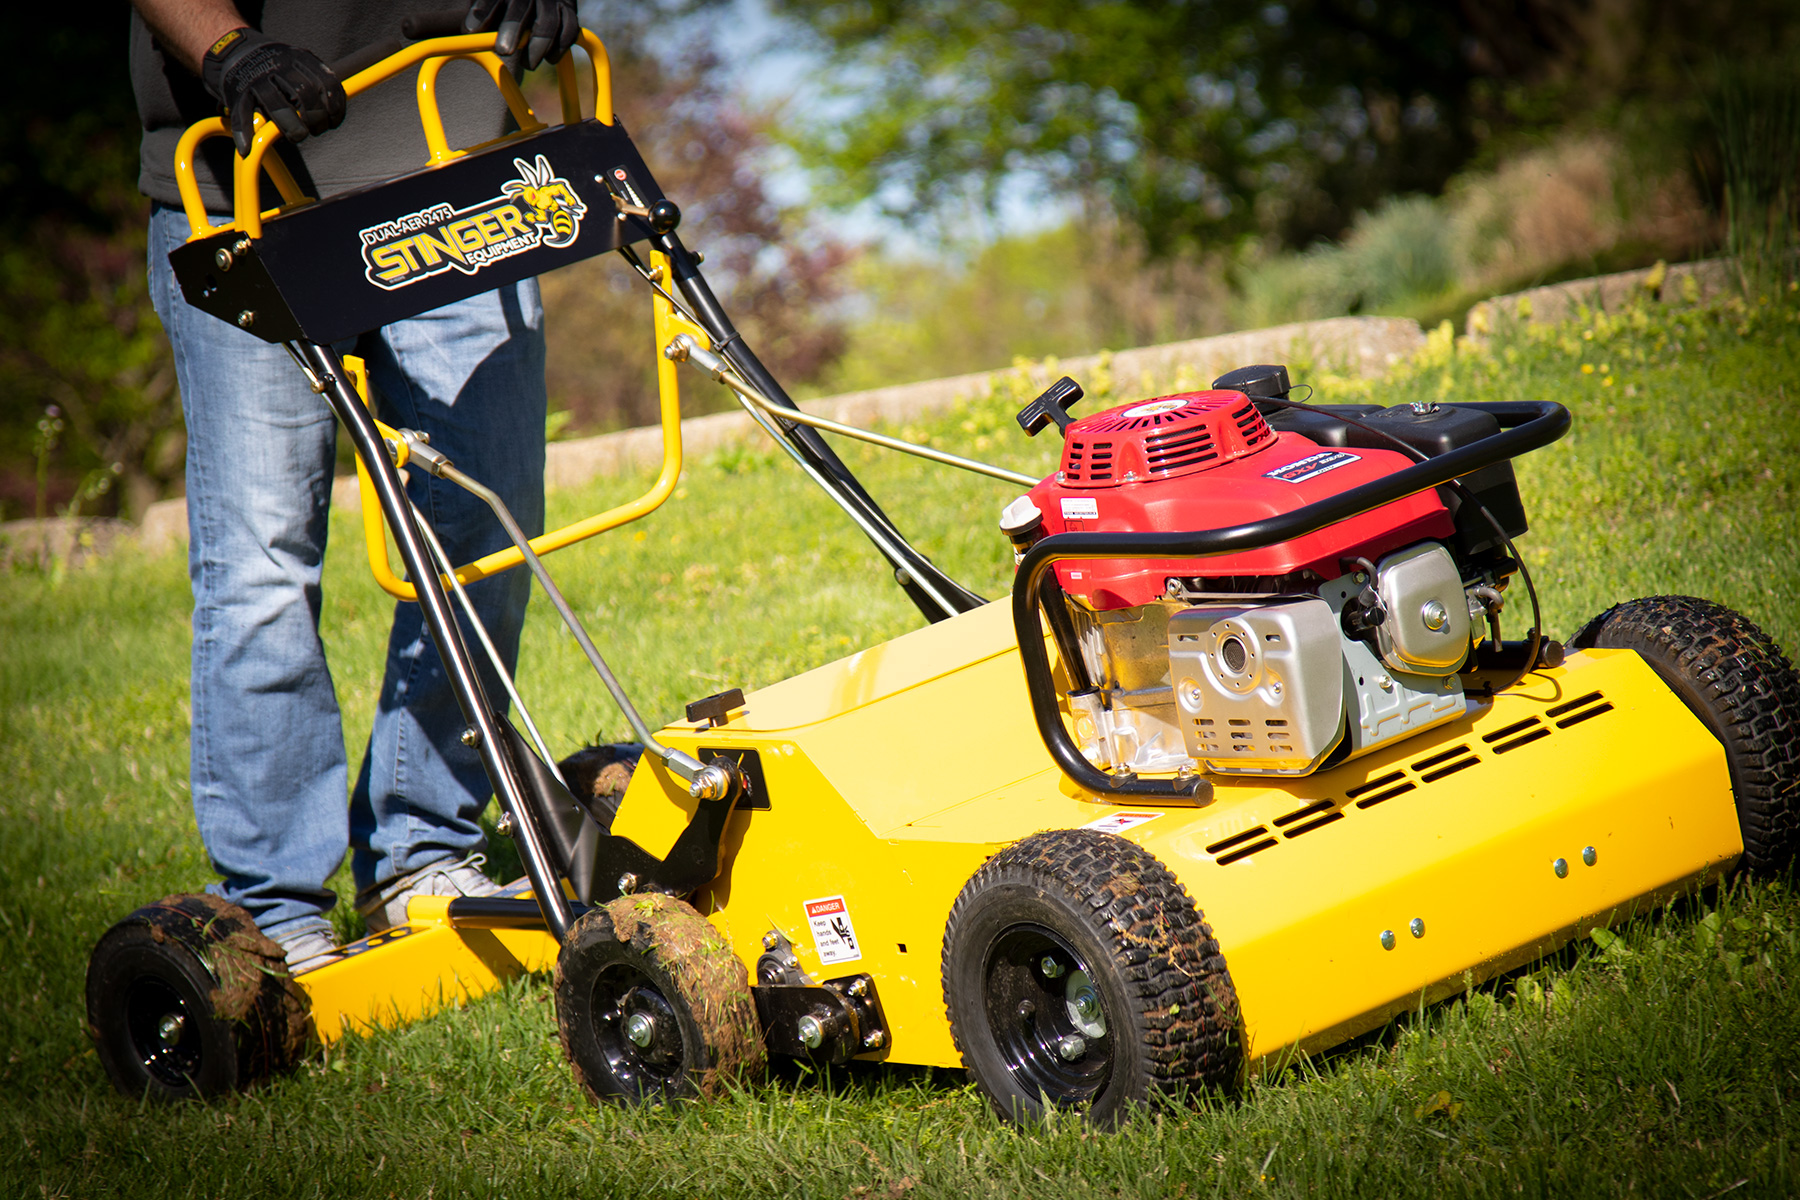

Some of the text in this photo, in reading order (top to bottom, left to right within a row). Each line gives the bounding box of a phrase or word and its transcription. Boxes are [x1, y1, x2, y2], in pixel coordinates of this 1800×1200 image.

[364, 206, 452, 245] DUAL-AER 2475
[371, 204, 533, 282] STINGER
[466, 232, 538, 265] EQUIPMENT
[1266, 452, 1333, 476] HONDA
[1282, 462, 1317, 479] GXV
[816, 902, 840, 913] DANGER
